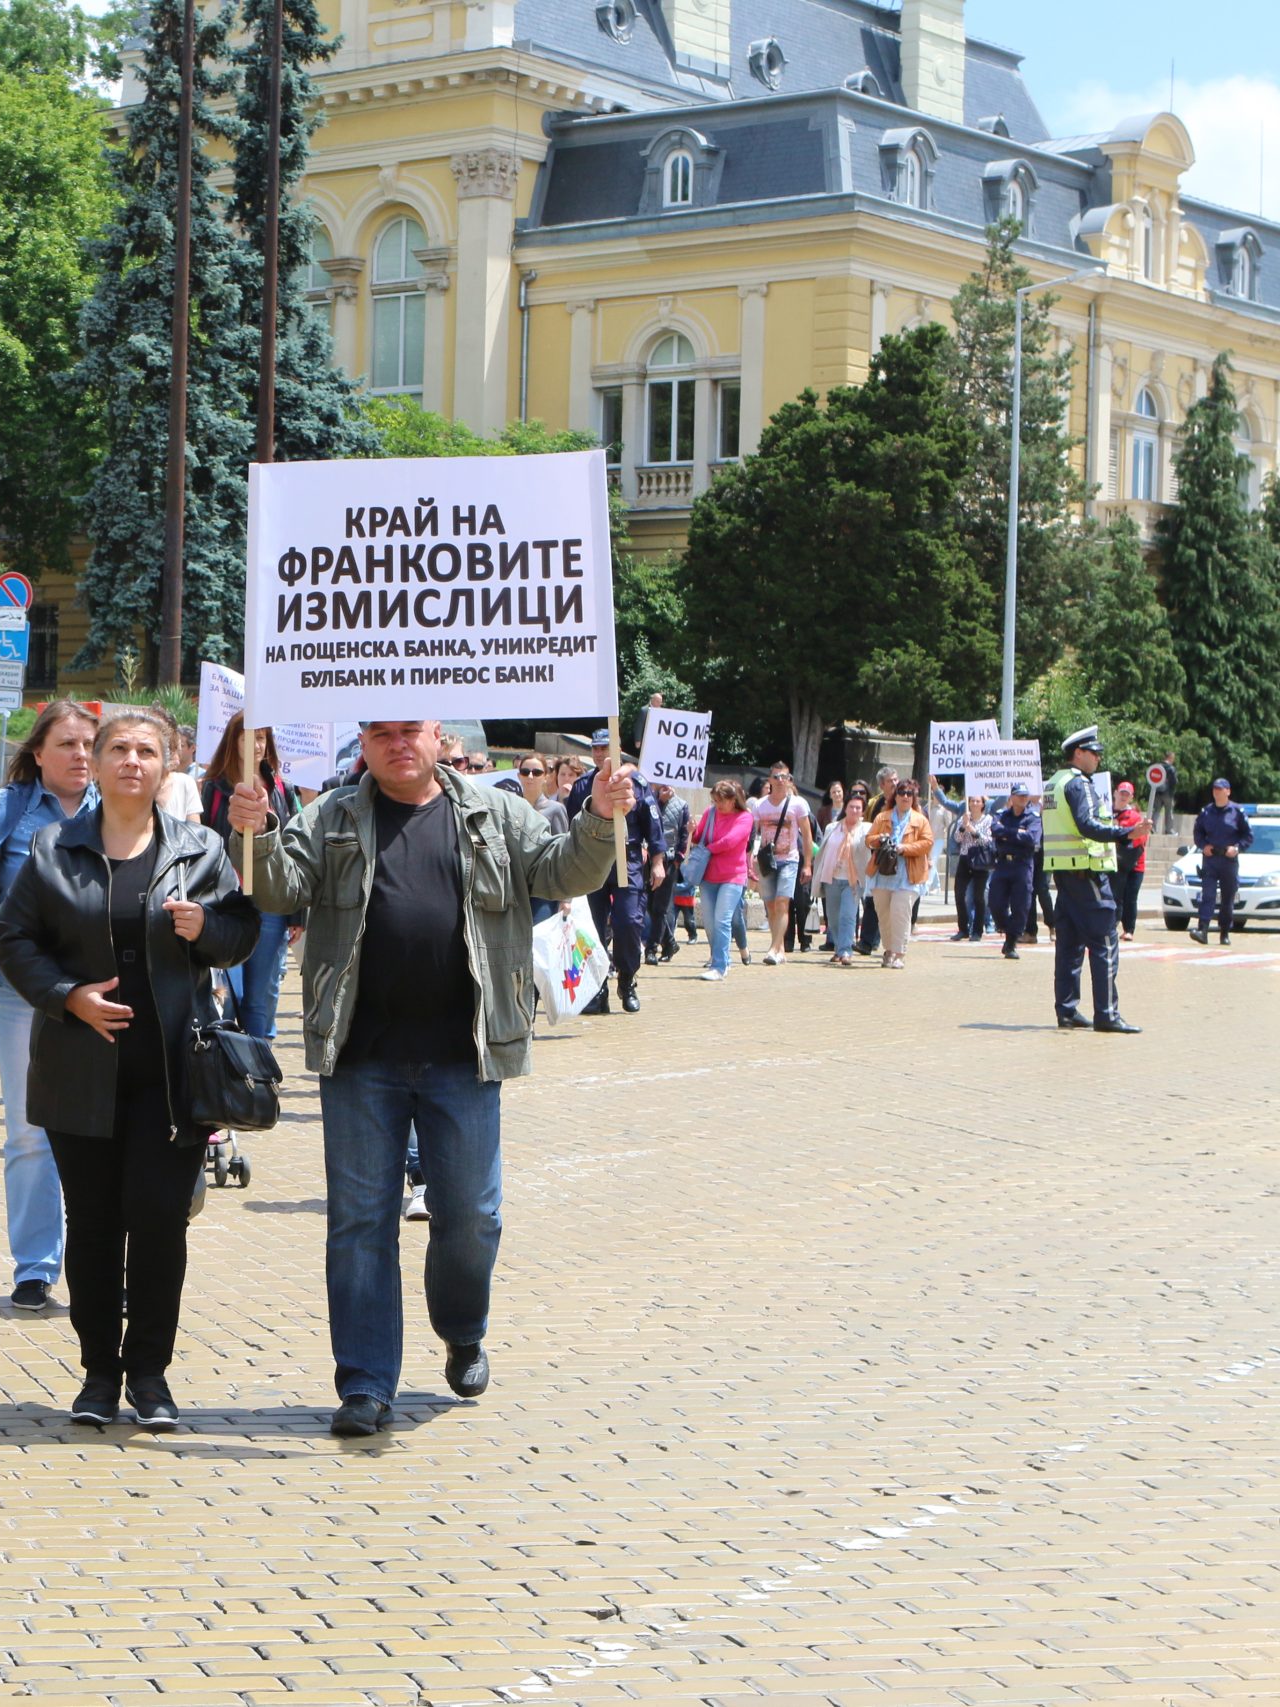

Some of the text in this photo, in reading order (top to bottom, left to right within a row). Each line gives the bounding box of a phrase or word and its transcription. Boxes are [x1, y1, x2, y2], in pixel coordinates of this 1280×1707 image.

[346, 497, 506, 538] КРАЙ НА
[278, 538, 584, 586] ФРАНКОВИТЕ
[276, 584, 584, 634] ИЗМИСЛИЦИ
[266, 635, 598, 664] НА ПОЩЕНСКА БАНКА, УНИКРЕДИТ
[301, 664, 554, 688] БУЛБАНК И ПИРЕОС БАНК!
[657, 720, 688, 737] NO
[939, 727, 992, 741] КРАЙ НА
[938, 758, 964, 768] РОБ
[963, 760, 1004, 768] ABRICATIONS
[975, 771, 1005, 779] UNICREDIT
